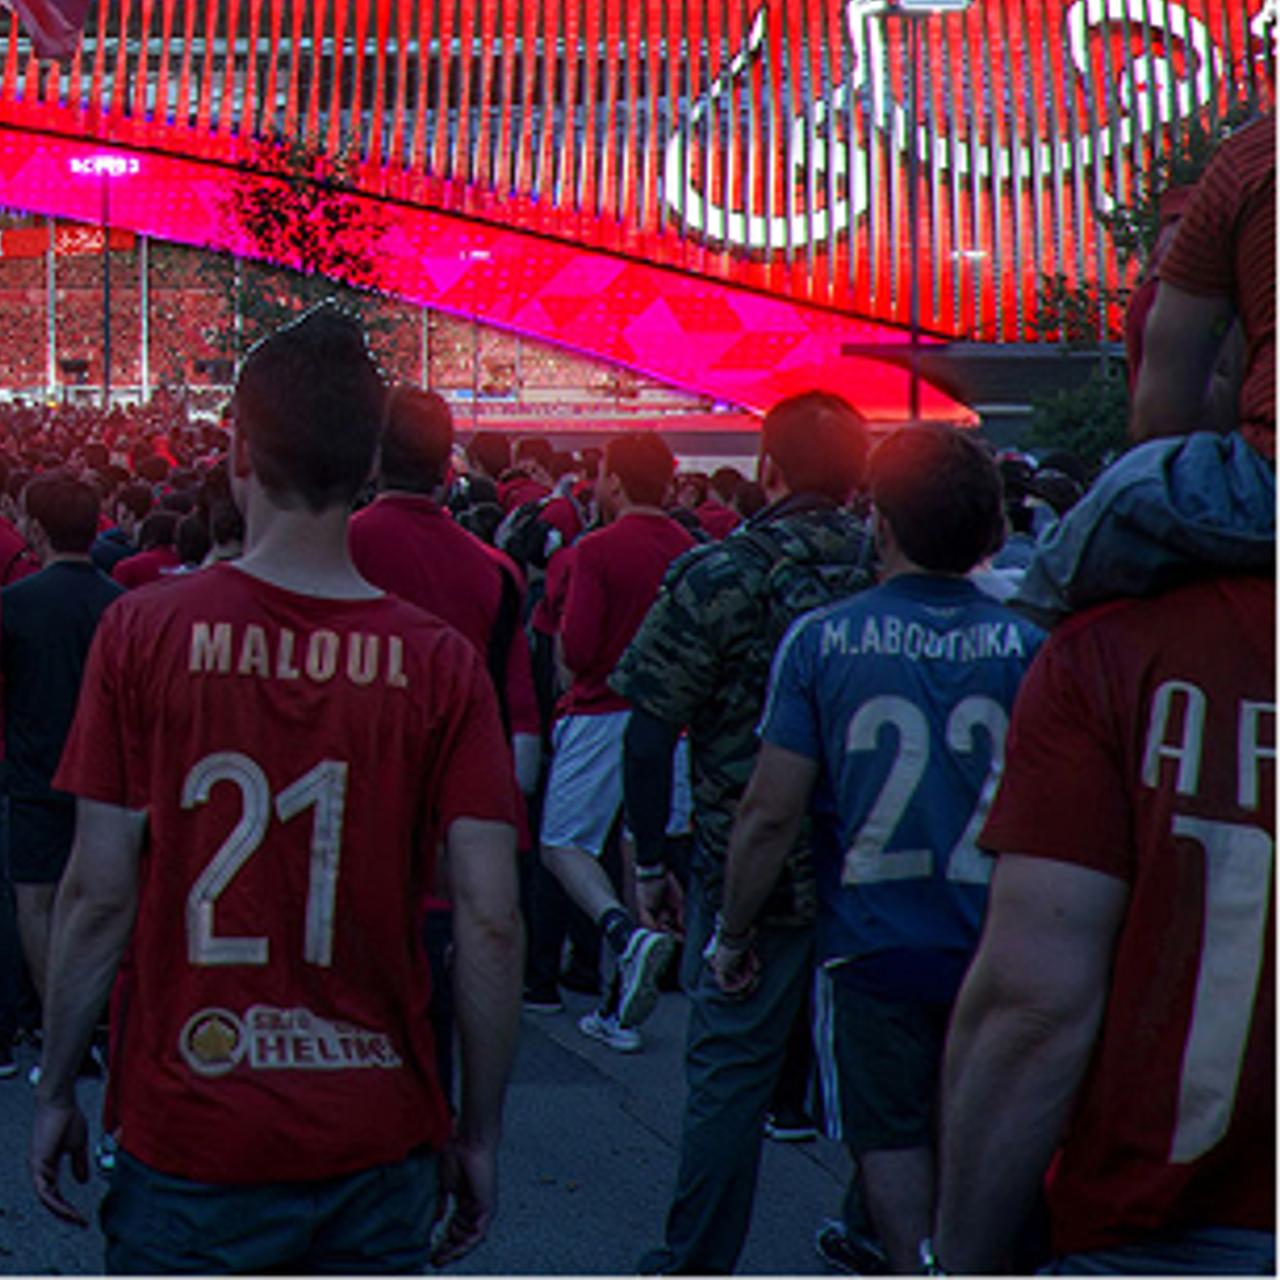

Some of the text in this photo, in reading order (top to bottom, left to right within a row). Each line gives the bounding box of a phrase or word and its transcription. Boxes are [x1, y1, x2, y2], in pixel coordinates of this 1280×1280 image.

[187, 622, 409, 688] MALOUL
[179, 751, 350, 968] 21
[842, 694, 1010, 888] 22
